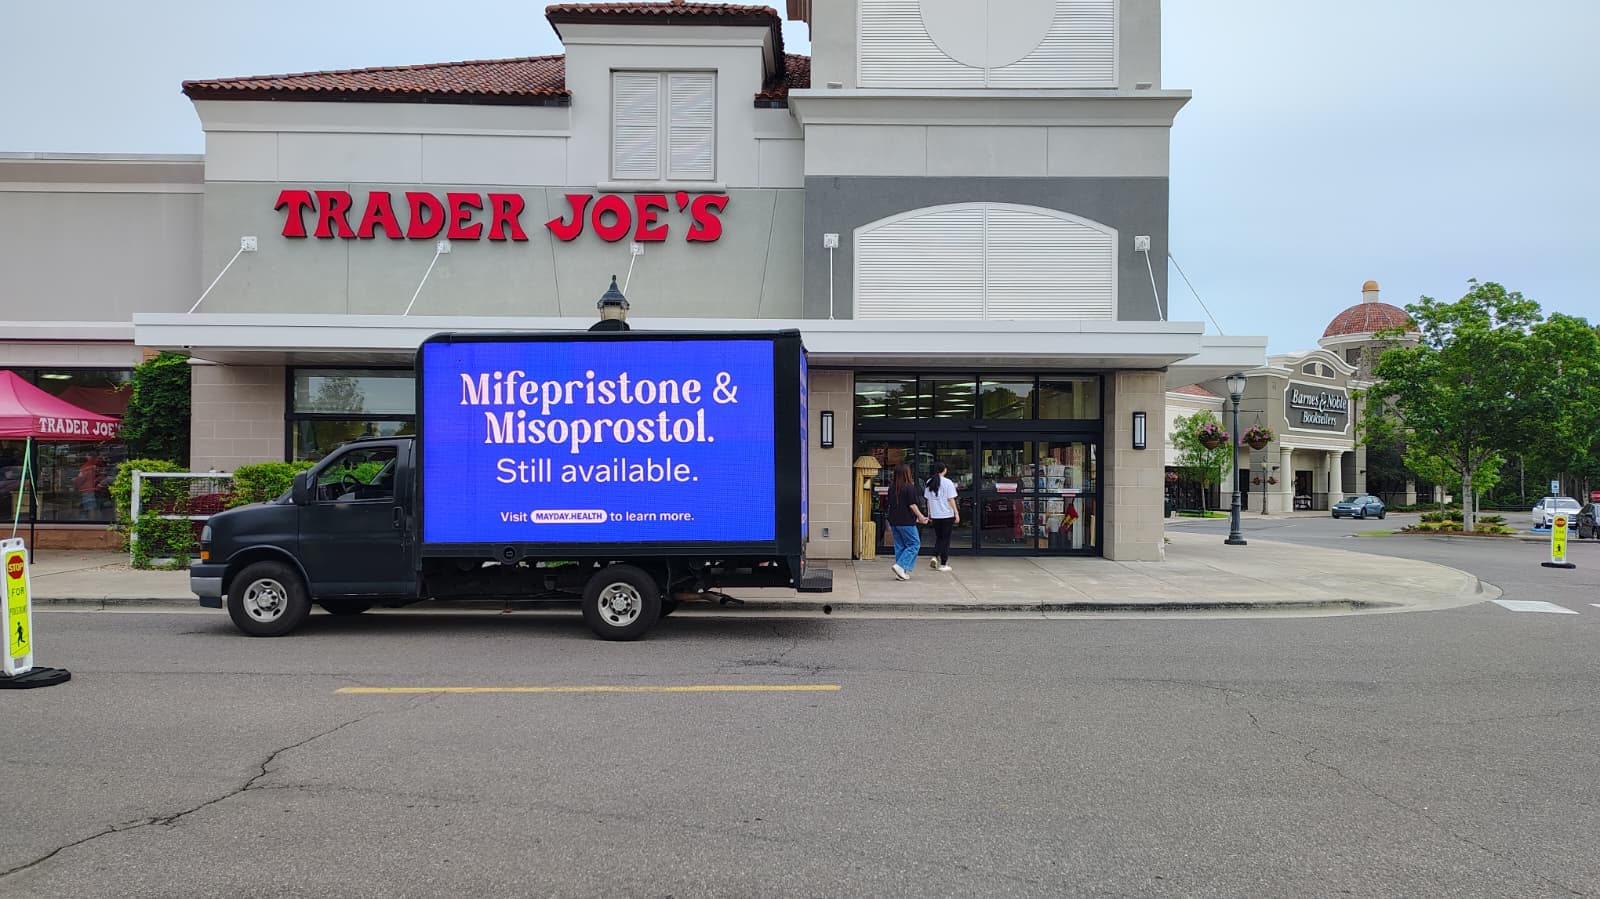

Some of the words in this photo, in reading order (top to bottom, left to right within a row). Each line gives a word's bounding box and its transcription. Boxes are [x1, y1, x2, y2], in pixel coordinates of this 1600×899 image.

[274, 189, 529, 241] TRADER
[544, 191, 730, 242] JOE'S
[460, 370, 702, 415] Mifepristone
[712, 371, 739, 404] &
[1292, 389, 1318, 406] Barnes
[1319, 391, 1327, 412] &
[1327, 395, 1347, 409] Noble
[38, 417, 89, 434] TRADER
[484, 408, 715, 454] Misoprostol.
[496, 457, 552, 484] Still
[561, 457, 699, 483] available.
[500, 510, 528, 523] Visit
[535, 512, 604, 521] MAYDAY.HEALTH
[609, 511, 623, 522] to
[626, 510, 657, 522] learn
[660, 511, 695, 522] more.
[8, 562, 23, 573] STOP
[11, 586, 25, 597] FOR
